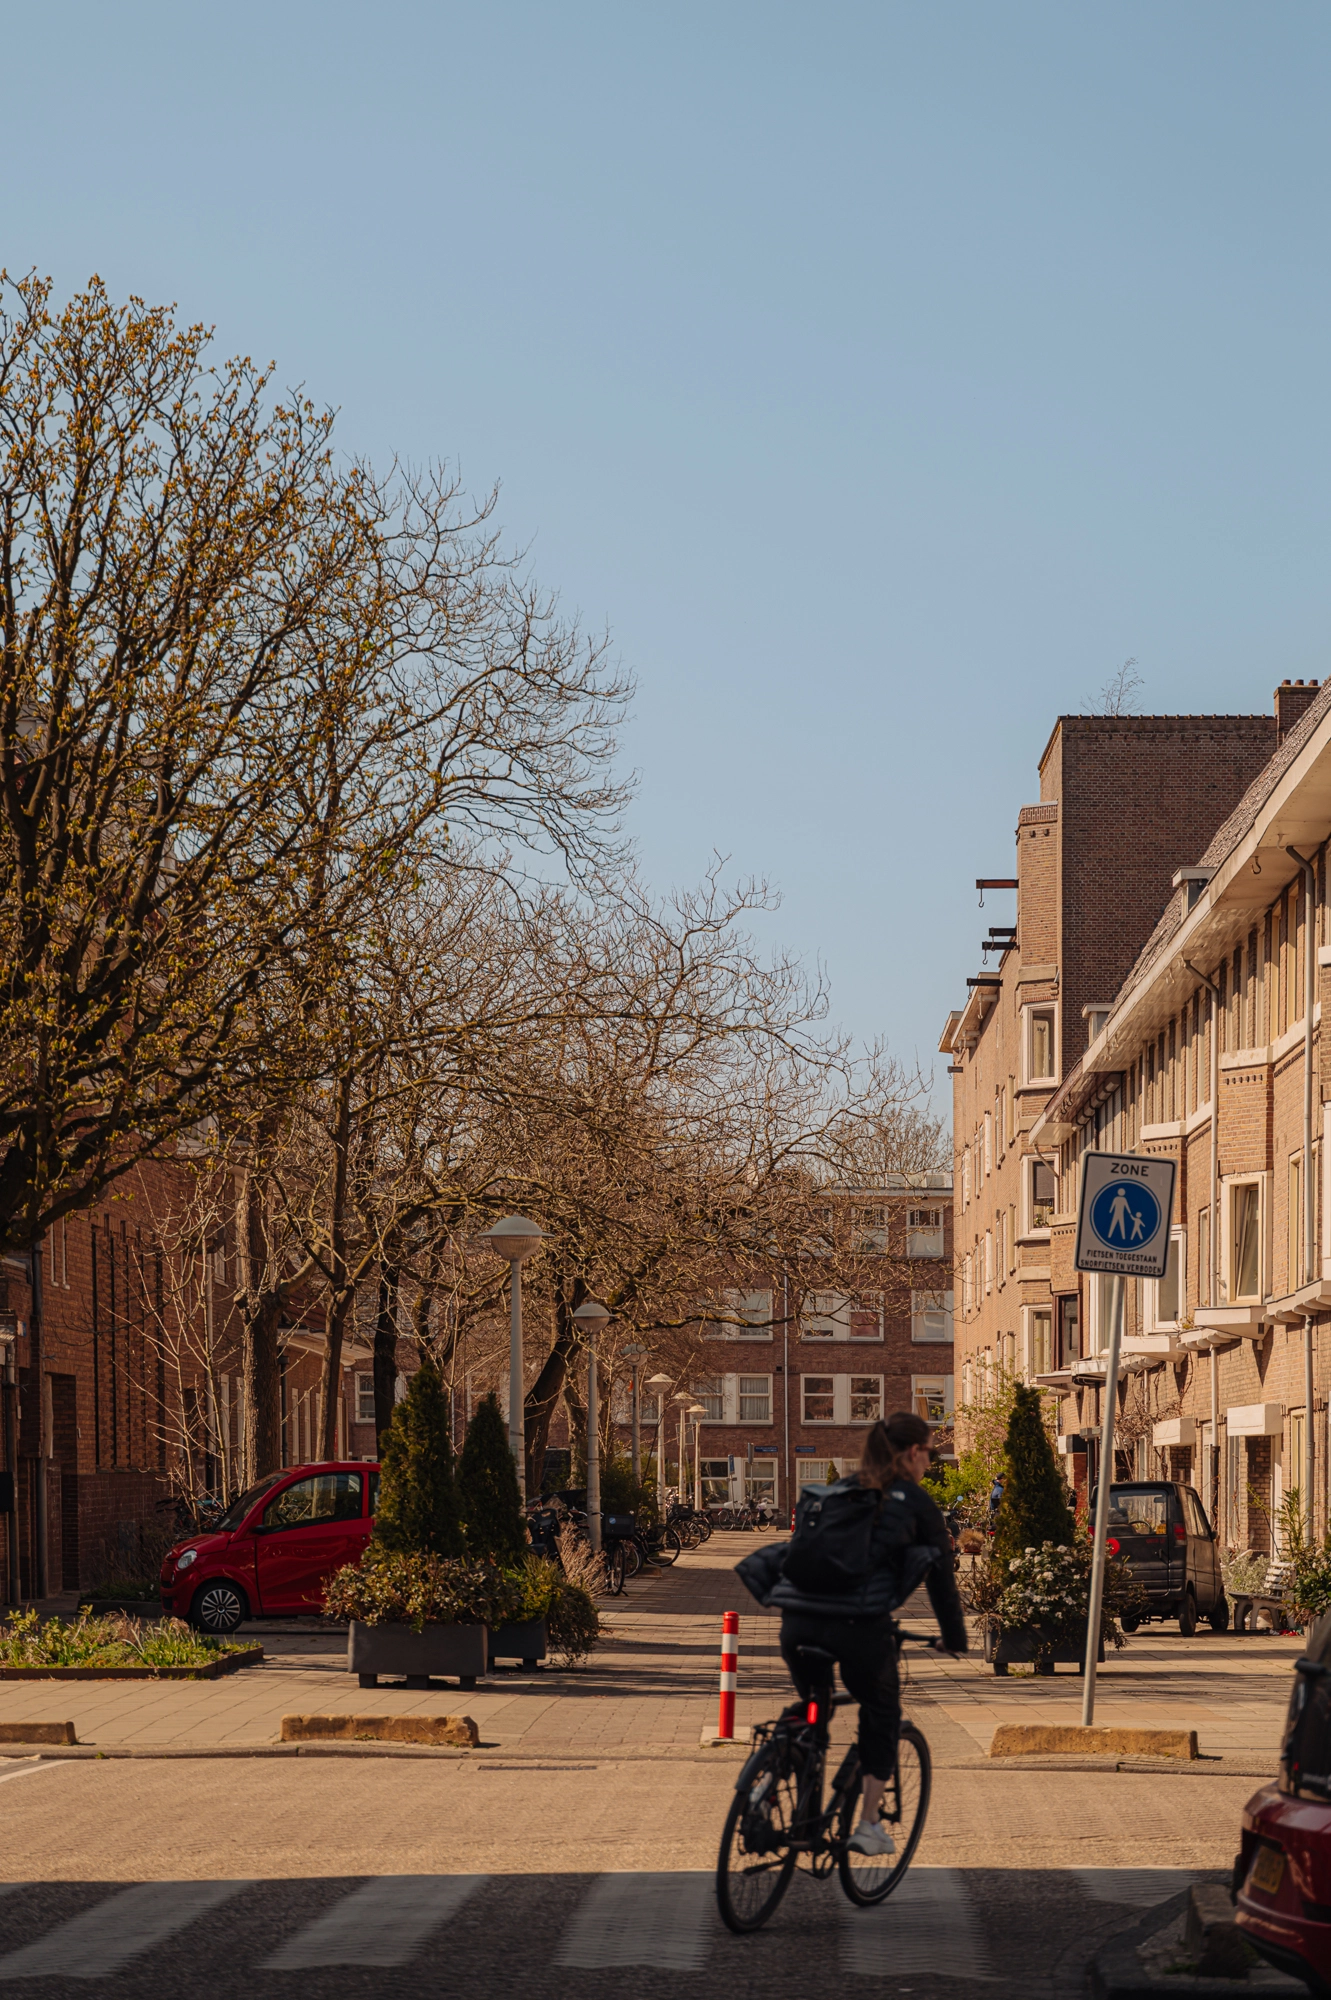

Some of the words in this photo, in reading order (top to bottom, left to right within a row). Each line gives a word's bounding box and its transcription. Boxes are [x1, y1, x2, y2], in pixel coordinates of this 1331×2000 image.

[1110, 1162, 1150, 1177] ZONE
[1086, 1249, 1114, 1259] FIETSEN
[1115, 1252, 1157, 1263] TOEGESTAAN
[1080, 1259, 1125, 1270] SNORFIETSEN
[1126, 1263, 1161, 1273] VERBODEN
